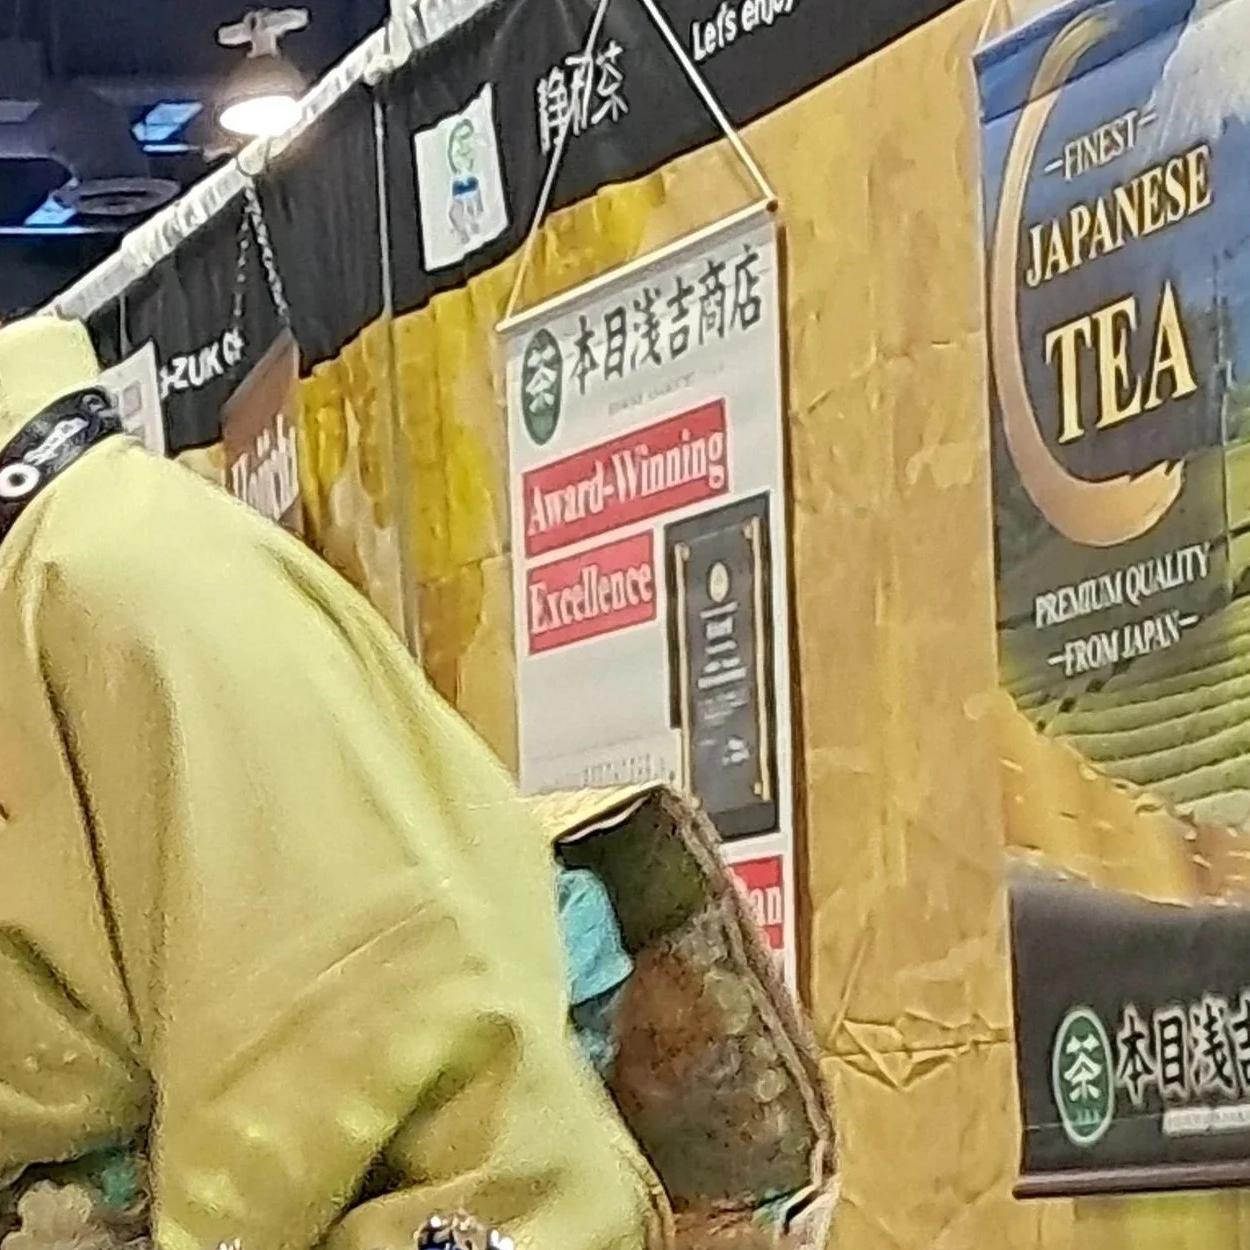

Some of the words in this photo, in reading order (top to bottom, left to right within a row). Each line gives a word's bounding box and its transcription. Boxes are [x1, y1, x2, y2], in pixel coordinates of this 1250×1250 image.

[1026, 144, 1212, 288] JAPANESE
[1045, 278, 1198, 445] TEA
[527, 428, 726, 536] Award-Winning
[529, 561, 654, 634] Excellence
[1035, 570, 1123, 629] PREMIUM
[1126, 542, 1211, 606] QUALITY
